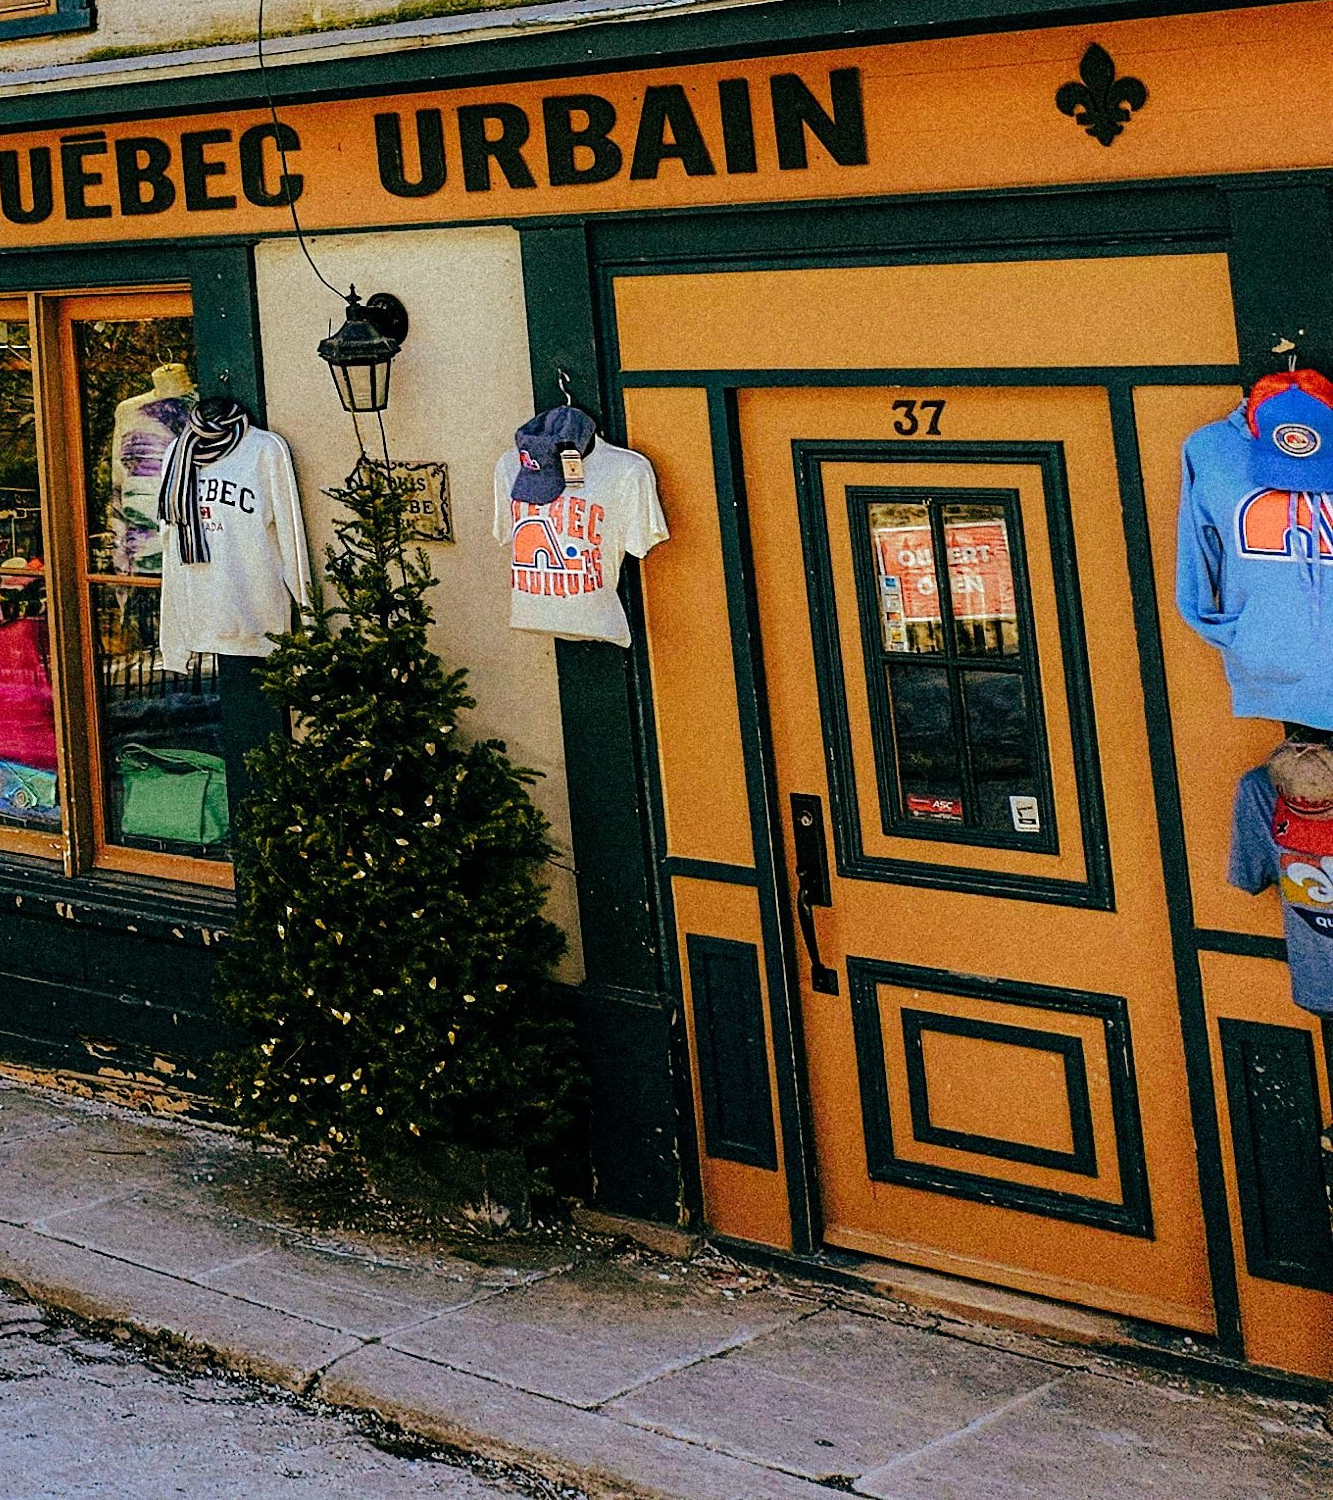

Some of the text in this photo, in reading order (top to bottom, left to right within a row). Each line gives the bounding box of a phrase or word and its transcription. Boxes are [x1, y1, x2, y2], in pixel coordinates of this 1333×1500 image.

[374, 67, 870, 198] URBAIN
[891, 399, 946, 436] 37
[897, 545, 990, 568] OUERT
[916, 573, 985, 596] OEN
